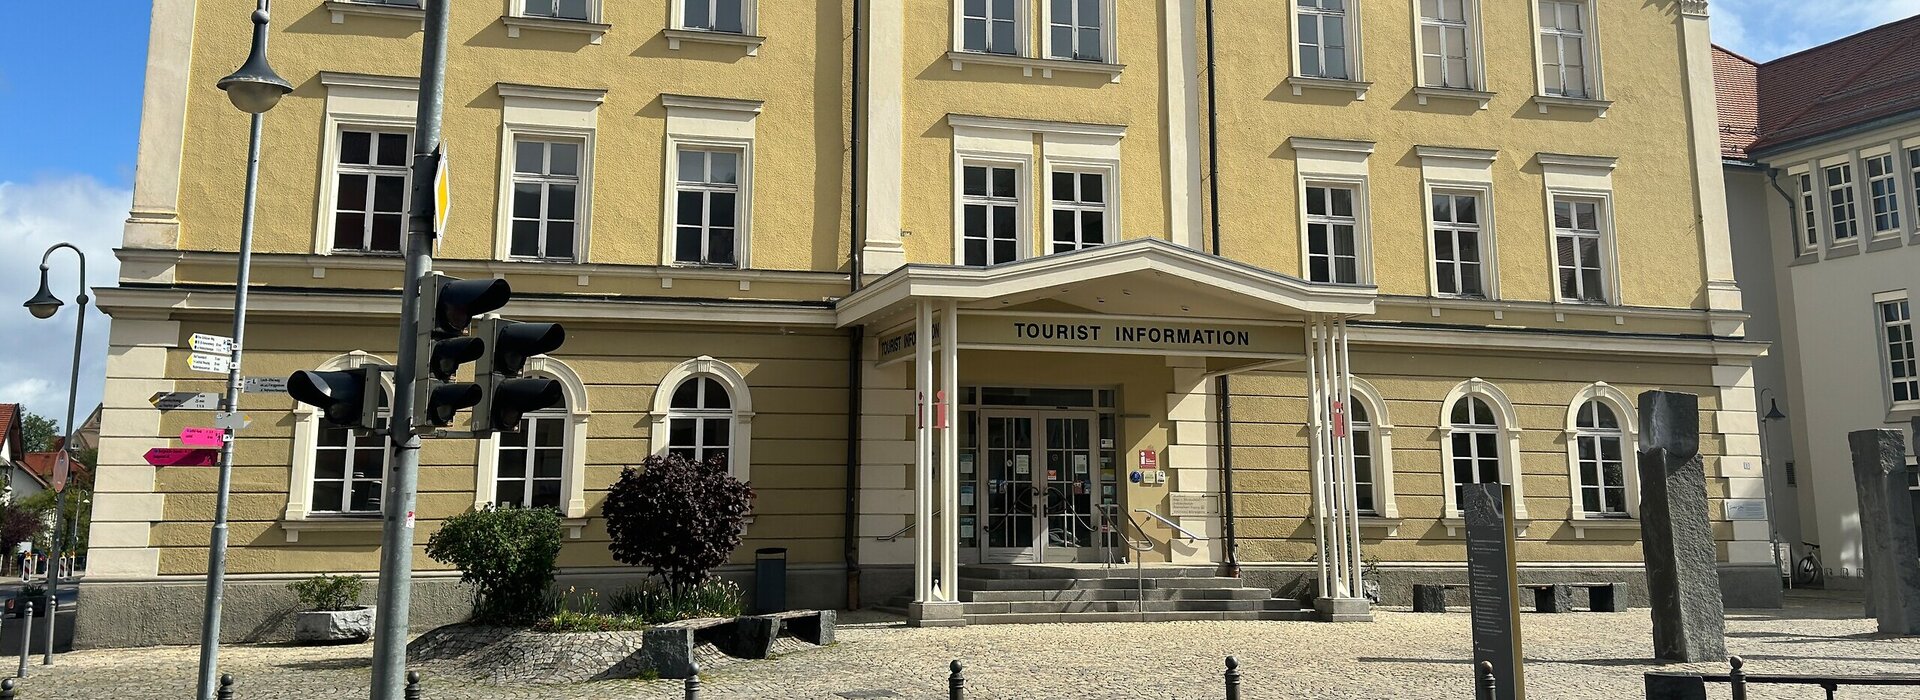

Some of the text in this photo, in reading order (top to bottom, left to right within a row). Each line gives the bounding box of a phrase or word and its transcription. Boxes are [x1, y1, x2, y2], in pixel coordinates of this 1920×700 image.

[1014, 323, 1249, 345] TOURIST INFORMATION
[881, 336, 901, 356] TOURIST
